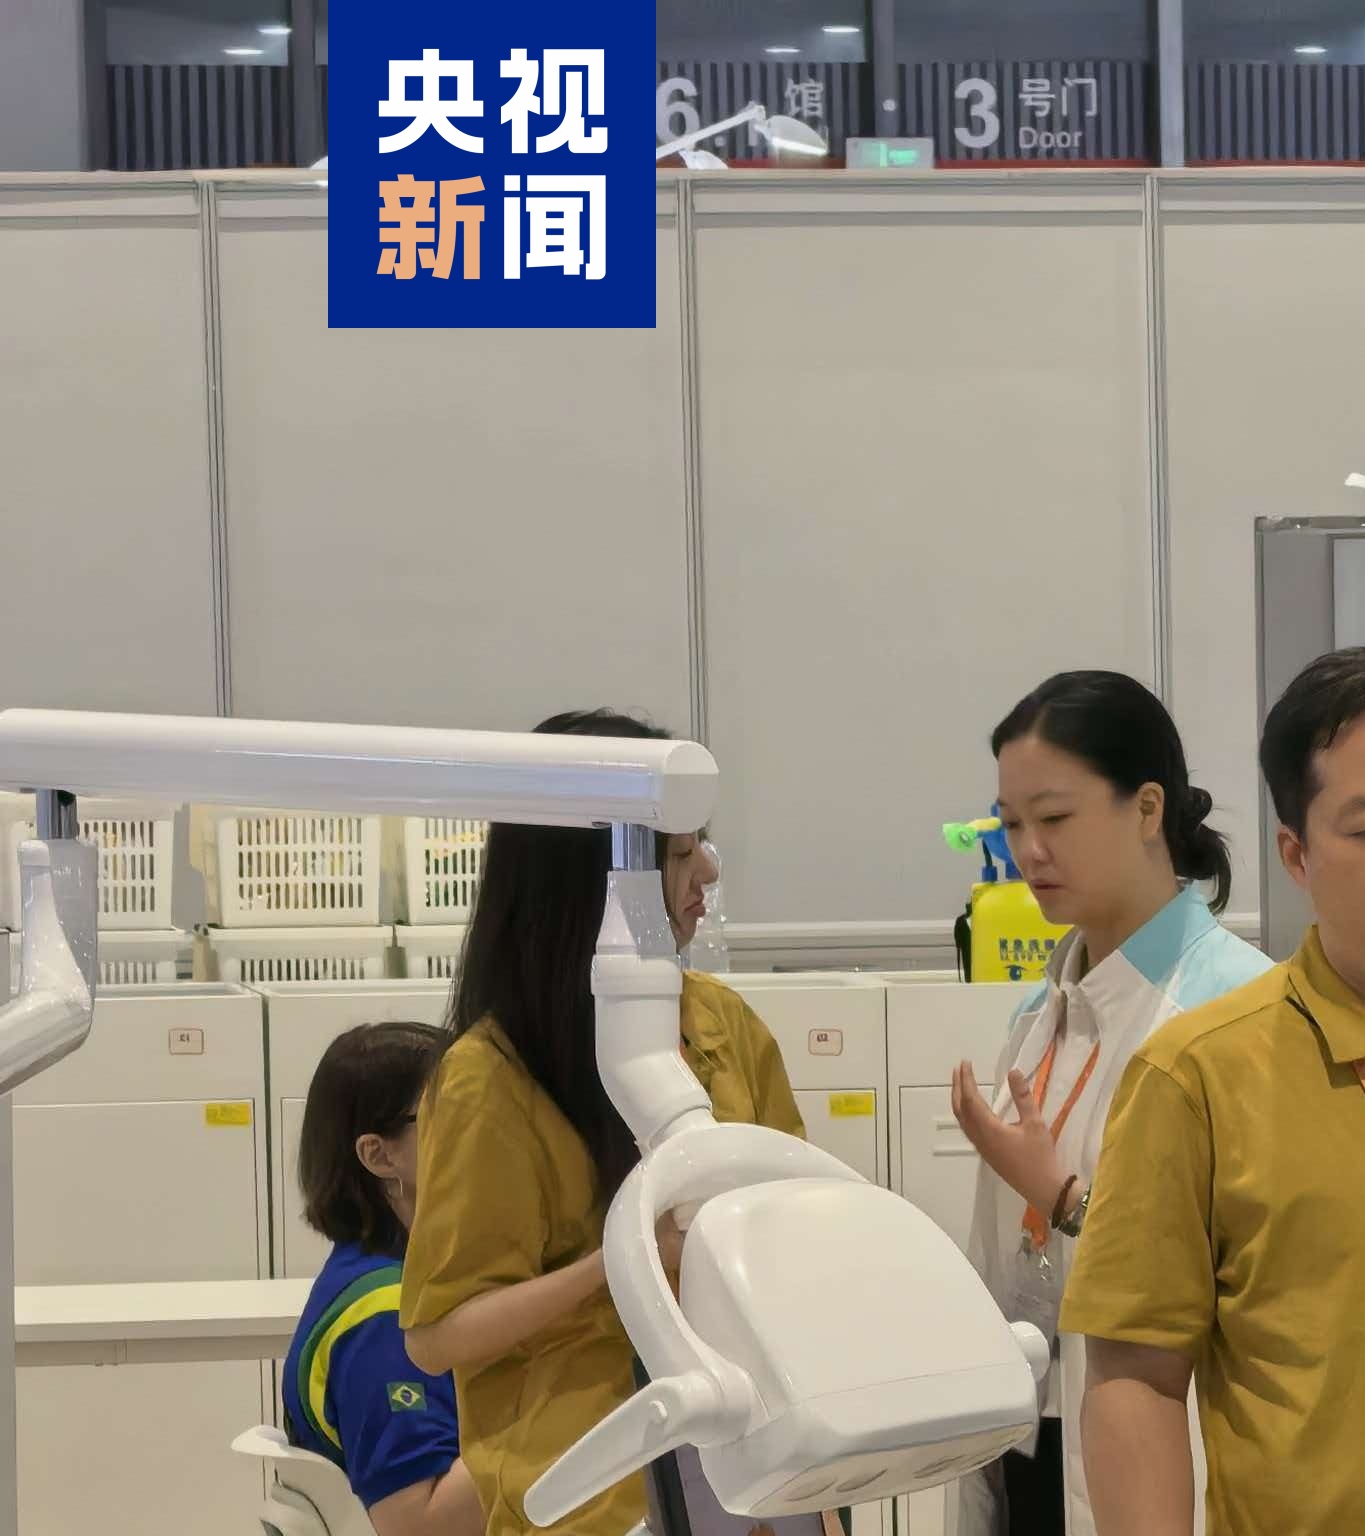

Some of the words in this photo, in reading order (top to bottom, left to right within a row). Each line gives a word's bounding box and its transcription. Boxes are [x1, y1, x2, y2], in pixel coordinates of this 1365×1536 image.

[955, 78, 1000, 149] 3
[1018, 78, 1097, 117] 号门
[1019, 127, 1082, 149] Door
